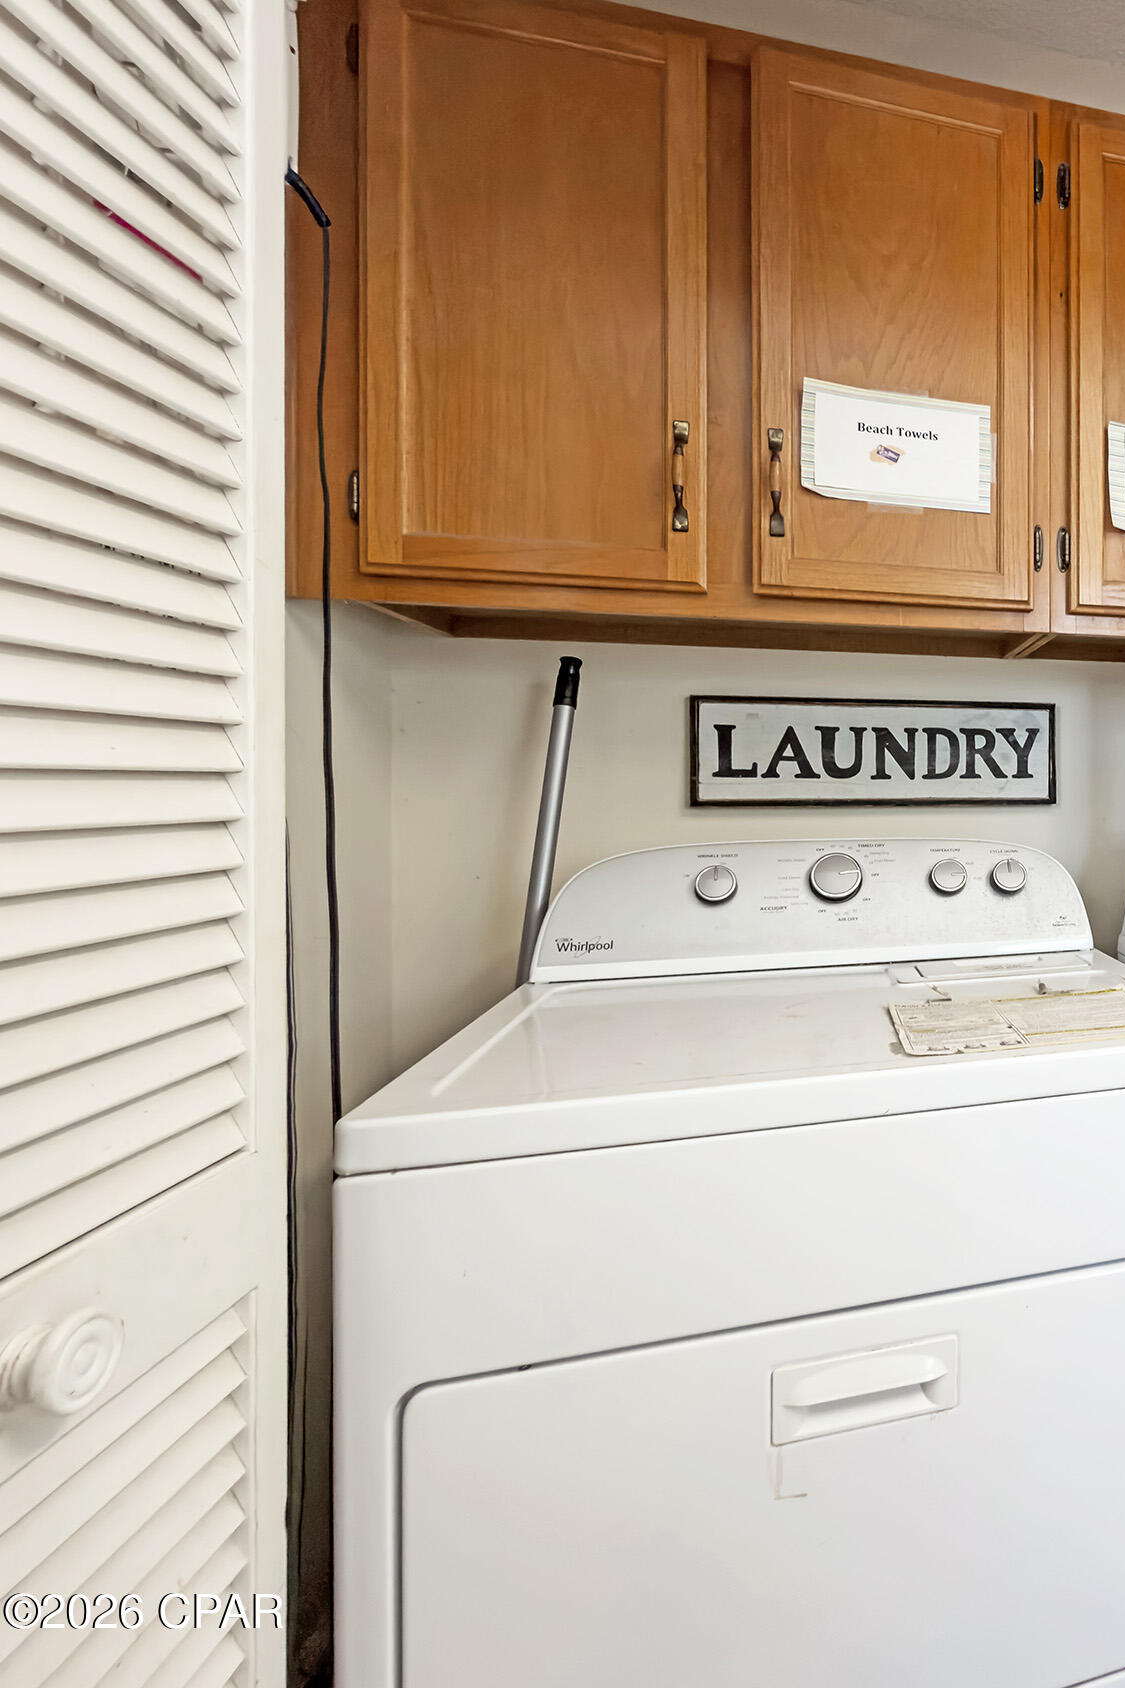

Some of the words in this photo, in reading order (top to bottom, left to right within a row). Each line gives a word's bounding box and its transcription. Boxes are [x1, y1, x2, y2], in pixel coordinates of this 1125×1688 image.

[857, 421, 893, 436] Beach
[896, 426, 939, 442] Towels
[712, 723, 1041, 780] LAUNDRY
[556, 940, 614, 954] Whirlpool
